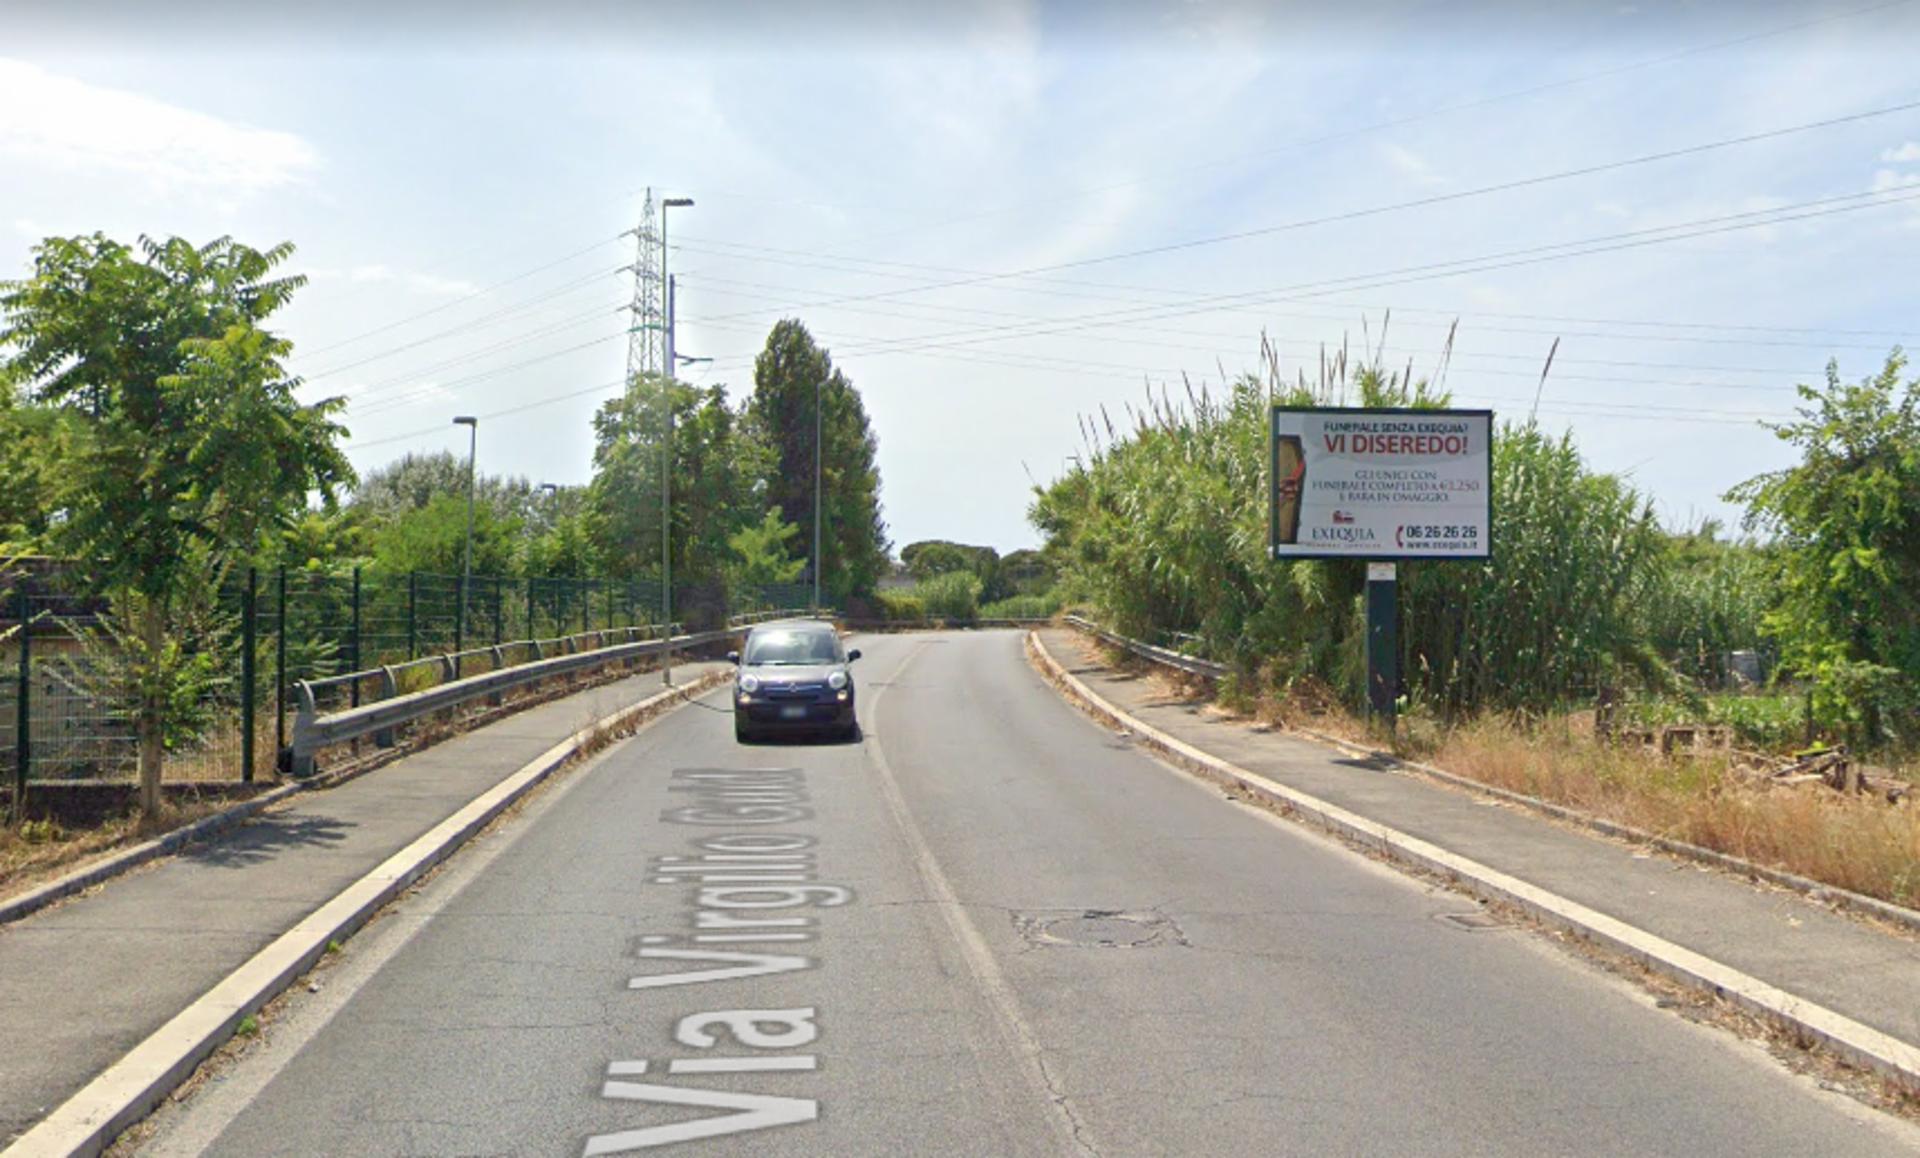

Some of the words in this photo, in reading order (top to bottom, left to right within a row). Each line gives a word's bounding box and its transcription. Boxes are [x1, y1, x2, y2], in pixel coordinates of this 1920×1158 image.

[1324, 421, 1379, 433] FUNERALE
[1381, 422, 1416, 433] SENZA
[1417, 422, 1469, 436] EXEQUIA?
[1323, 433, 1345, 454] VI
[1352, 433, 1468, 456] DISEREDO!
[1410, 470, 1437, 481] CON
[1311, 527, 1376, 543] EXEQUIA
[1406, 525, 1423, 539] 06
[1424, 525, 1442, 539] 26
[1443, 525, 1460, 539] 26
[1461, 525, 1478, 539] 26
